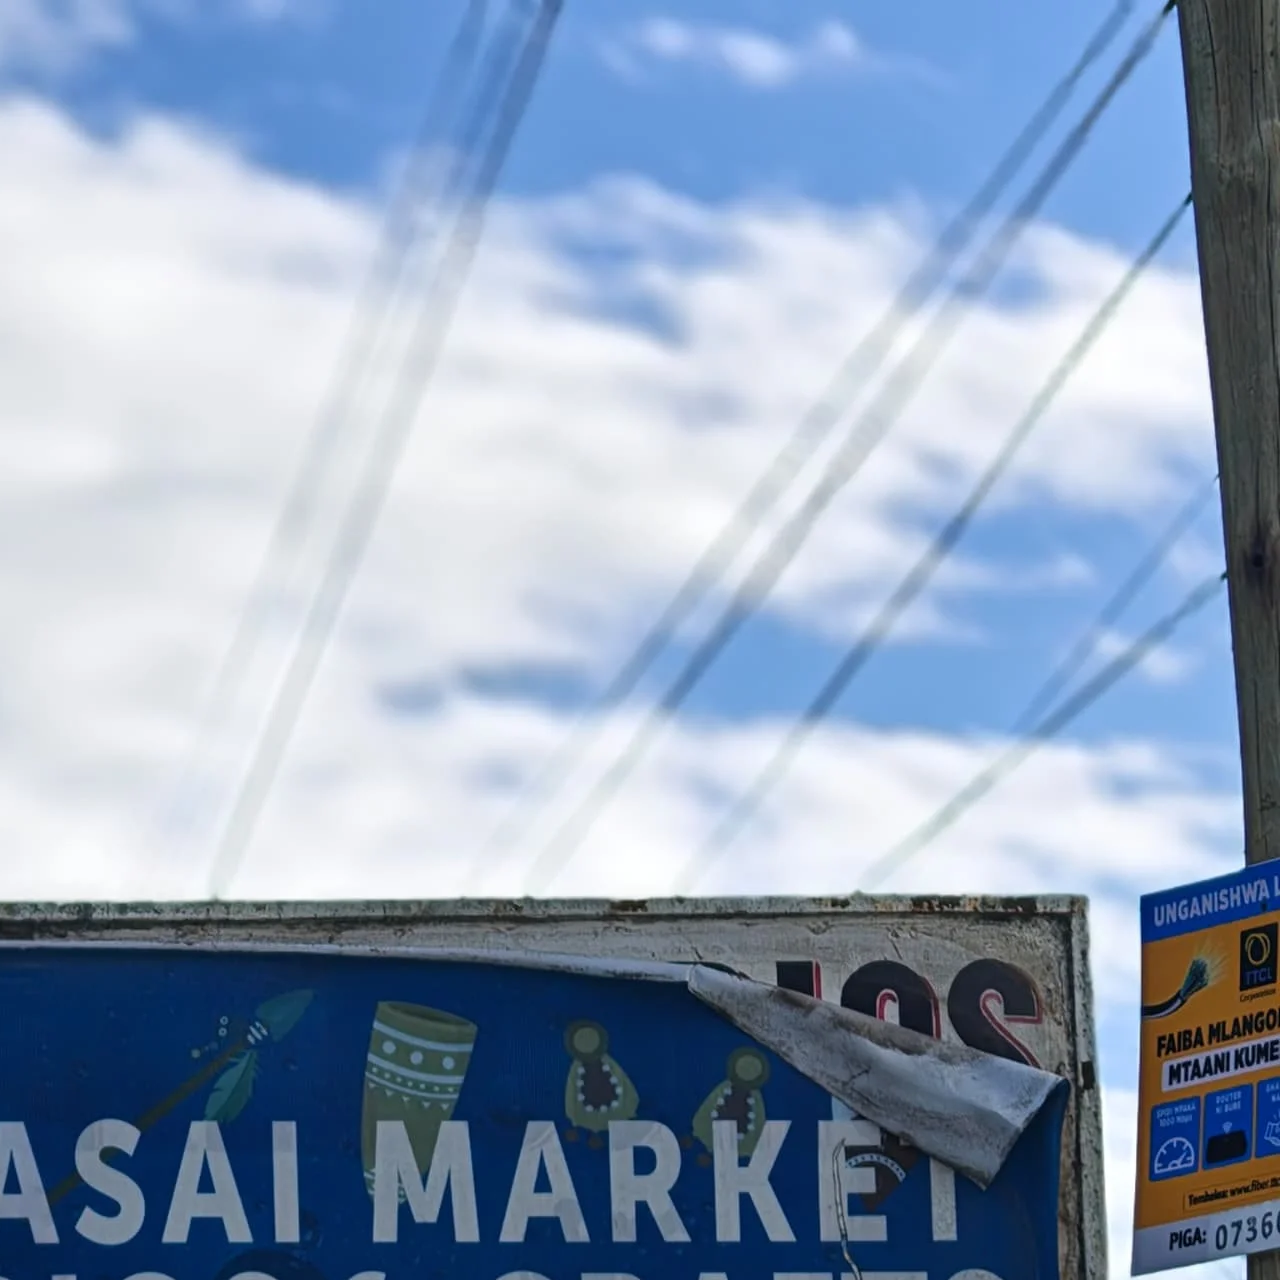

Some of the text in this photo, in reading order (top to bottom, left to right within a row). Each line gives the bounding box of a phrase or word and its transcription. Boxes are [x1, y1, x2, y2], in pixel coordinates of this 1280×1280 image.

[1153, 879, 1270, 927] UNGANISHWA
[1157, 1026, 1204, 1057] FAIBA
[1168, 1040, 1280, 1086] MTAANI KUME
[1169, 1226, 1207, 1251] PIGA:
